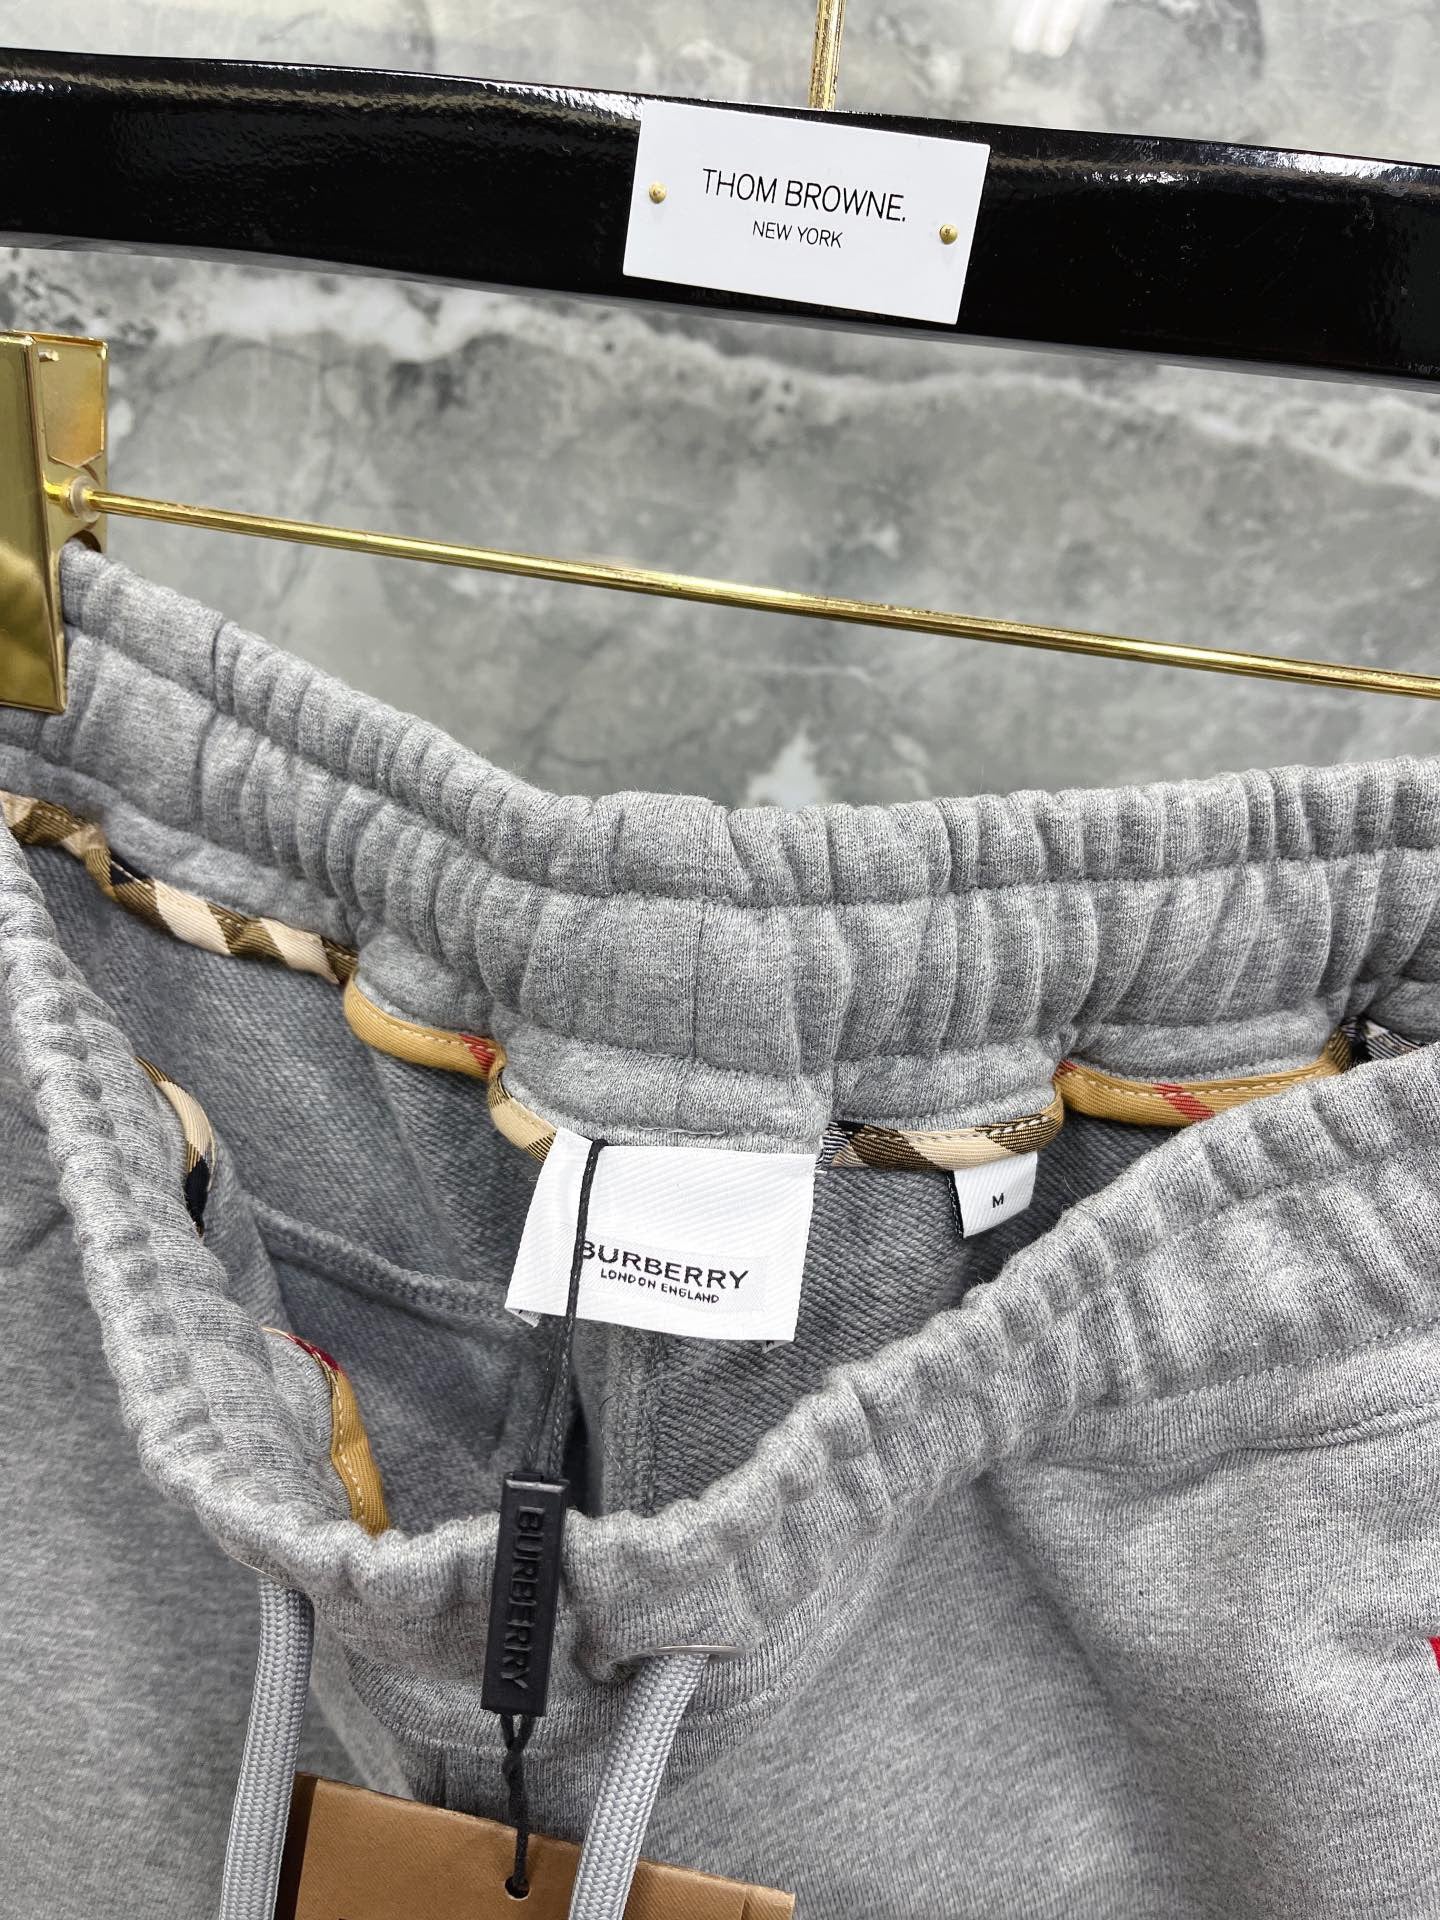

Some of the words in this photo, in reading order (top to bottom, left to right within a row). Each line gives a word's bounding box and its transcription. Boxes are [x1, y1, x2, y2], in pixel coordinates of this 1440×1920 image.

[703, 168, 778, 204] THOM
[785, 180, 907, 222] BROWNE.
[752, 219, 793, 241] NEW
[796, 226, 845, 249] YORK
[991, 1192, 1005, 1209] M
[581, 1239, 749, 1290] BURBERRY
[600, 1267, 657, 1290] LONDON
[660, 1282, 720, 1304] ENGLAND
[500, 1505, 546, 1690] BURBERRY
